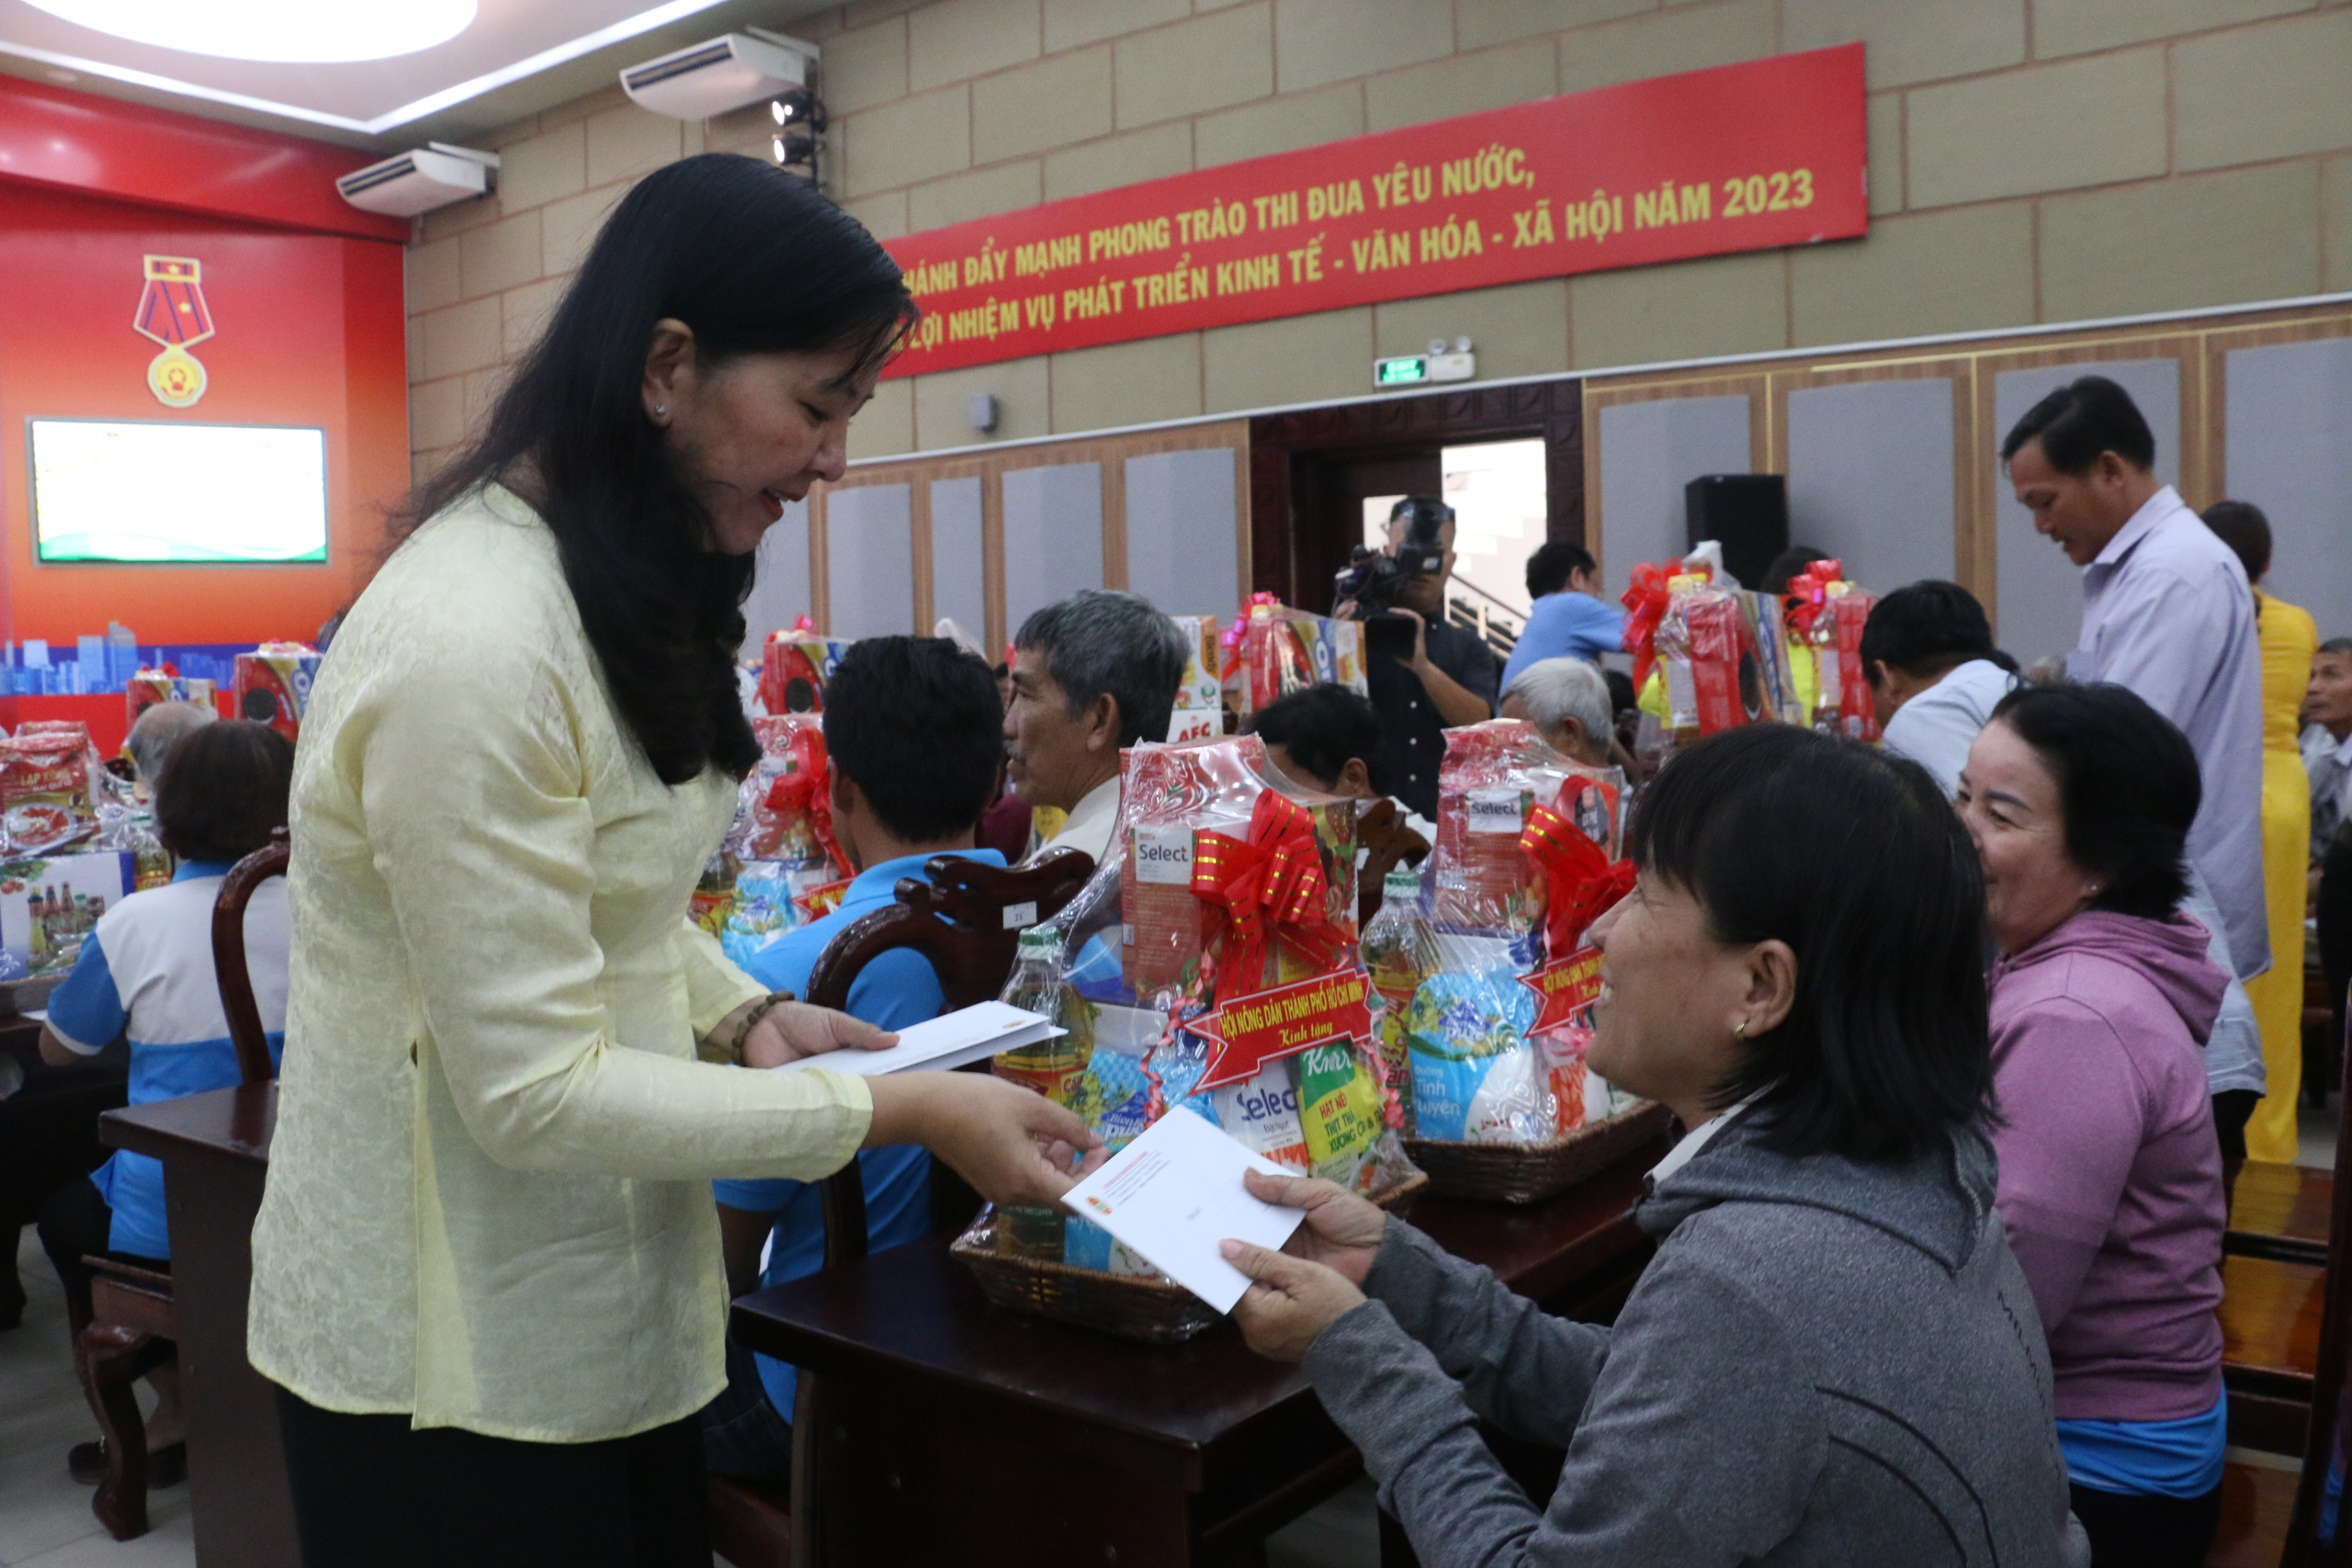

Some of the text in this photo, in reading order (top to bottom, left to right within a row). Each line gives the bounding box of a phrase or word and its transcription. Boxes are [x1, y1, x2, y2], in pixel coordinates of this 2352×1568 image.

[904, 142, 1535, 297] HÁNH ĐẨY MẠNH PHONG TRÀO THI ĐUA YÊU NƯỚC,
[949, 296, 1020, 342] NHIỆM
[1025, 293, 1056, 332] VỤ
[1064, 275, 1125, 321] PHÁT
[1132, 252, 1209, 310] TRIỂN
[1216, 254, 1280, 296] KINH
[1287, 231, 1326, 284] TẾ
[1333, 258, 1344, 269] -
[1351, 229, 1410, 274] VĂN
[1419, 212, 1483, 264] HÓA
[1492, 232, 1504, 243] -
[1512, 198, 1555, 250] XÃ
[1566, 188, 1623, 244] HỘI
[1634, 180, 1711, 230] NĂM
[1722, 167, 1815, 218] 2023
[1472, 802, 1517, 816] Select
[1139, 843, 1189, 863] Select
[1219, 1009, 1238, 1042] HỘI
[1236, 1004, 1264, 1034] NÔNG
[1263, 998, 1283, 1028] DÂN
[1282, 992, 1311, 1022] THÀNH
[1309, 981, 1328, 1014] PHỐ
[1347, 979, 1365, 1003] MINH
